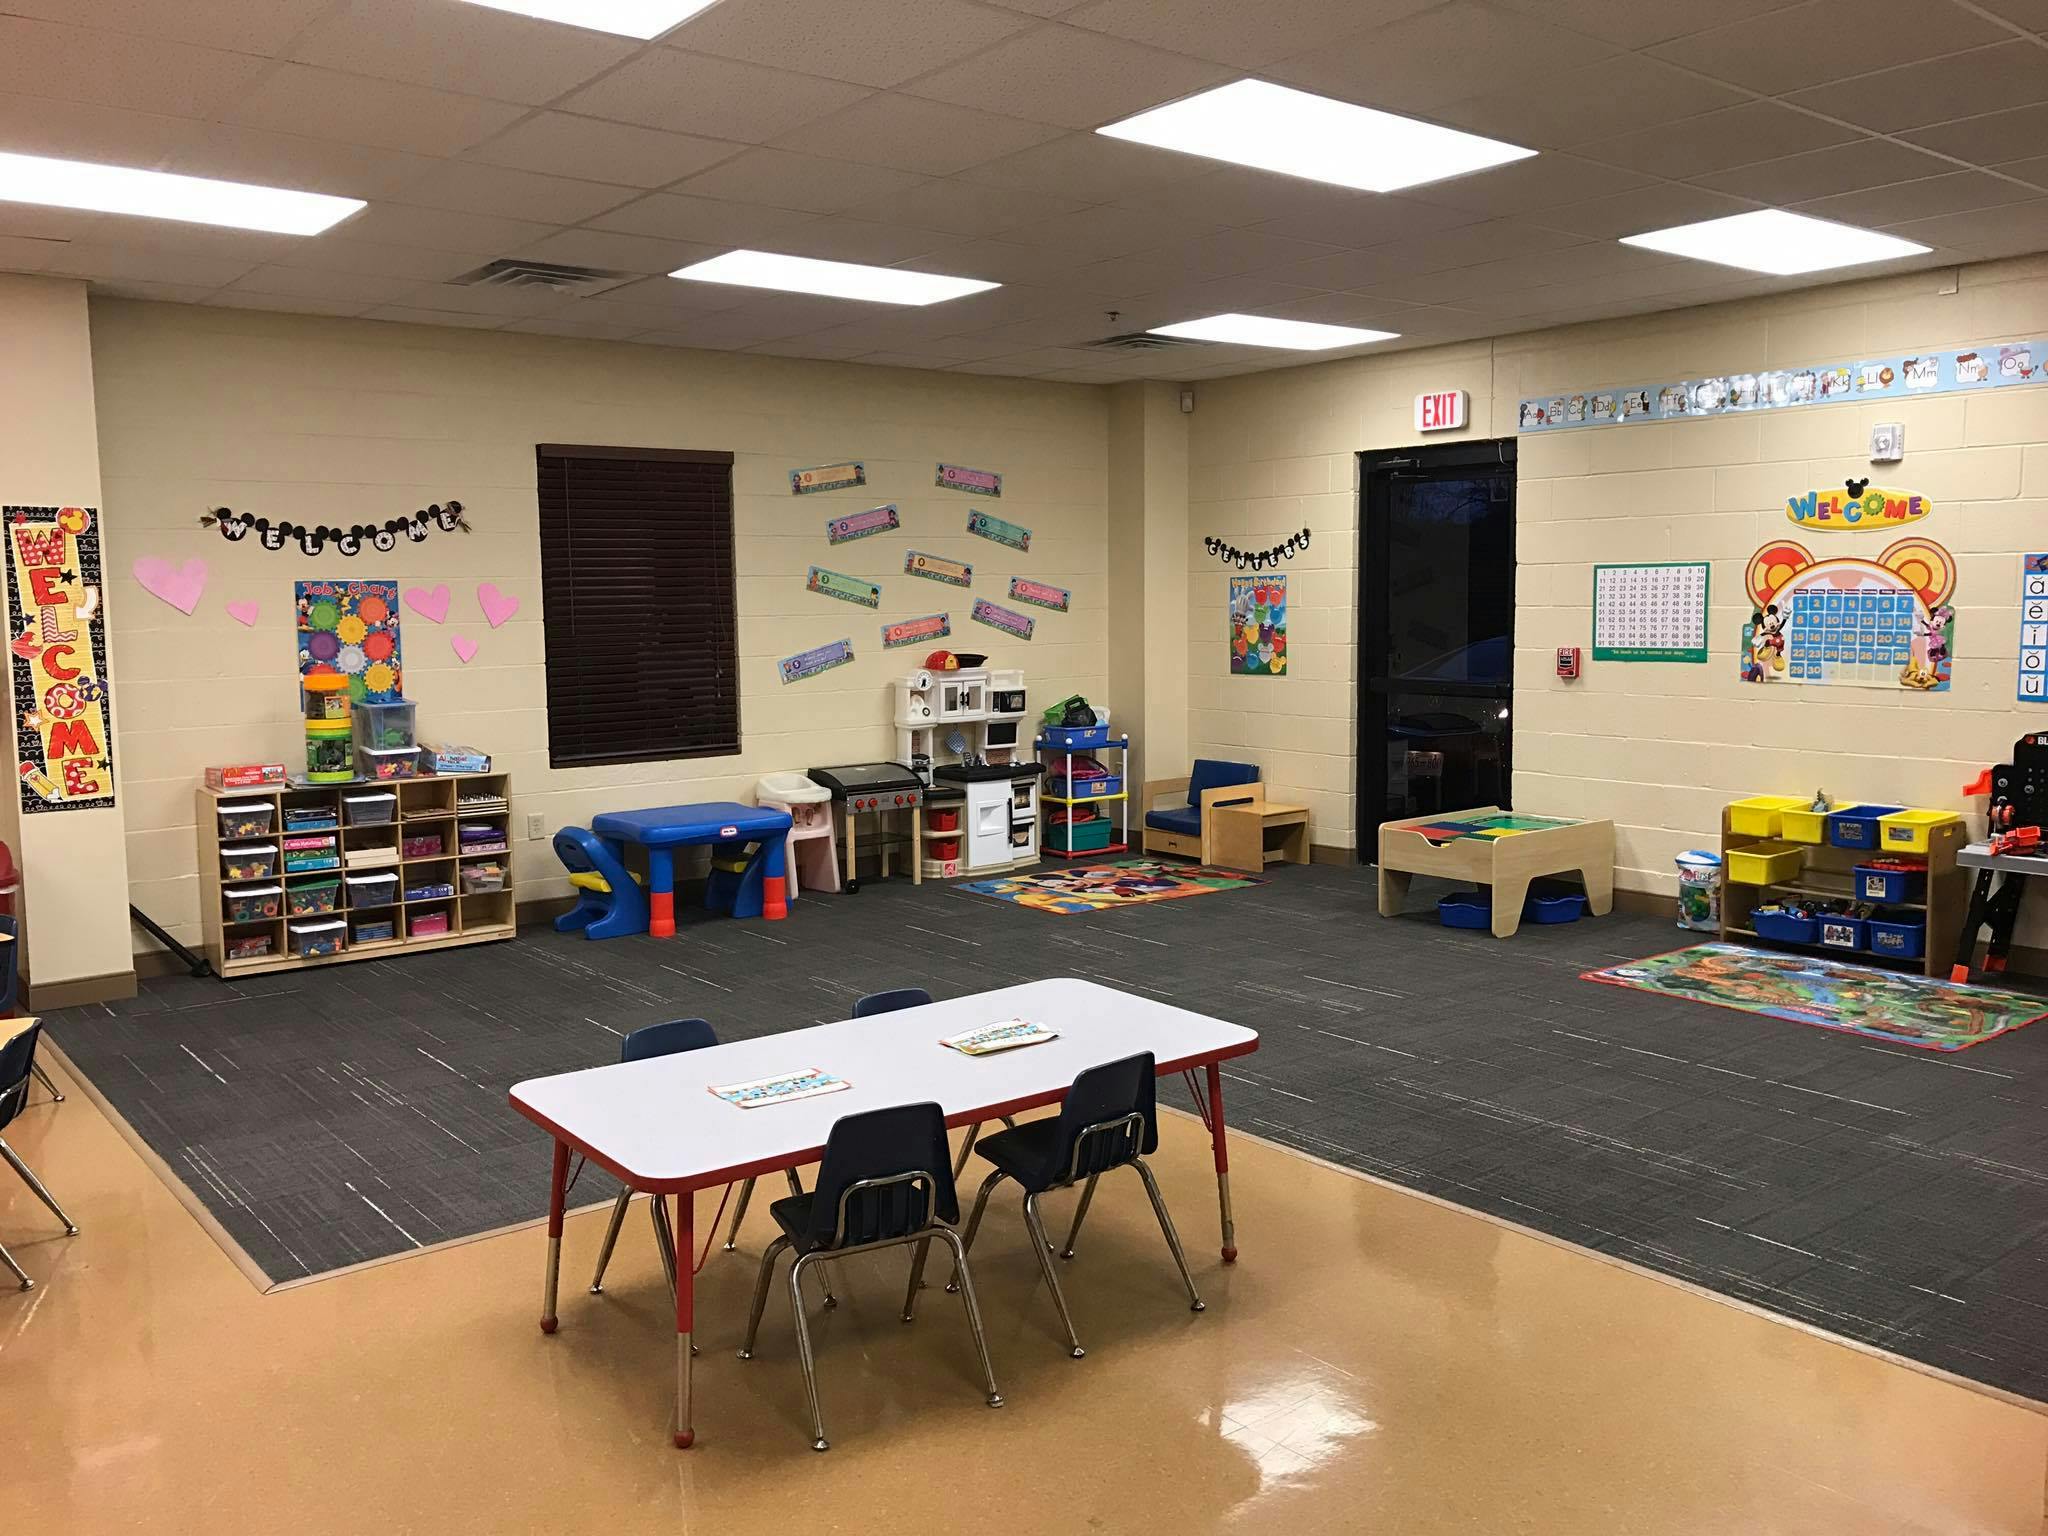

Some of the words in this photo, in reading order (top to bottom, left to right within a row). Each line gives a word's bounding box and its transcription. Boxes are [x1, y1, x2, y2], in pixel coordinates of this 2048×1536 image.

[1550, 407, 1561, 416] Bb
[1597, 401, 1609, 411] Dd
[1630, 398, 1641, 408] Ee
[1832, 375, 1848, 387] Kk
[1913, 367, 1936, 379] Mm
[1959, 363, 1976, 374] Nn
[2004, 357, 2024, 369] Oo
[1423, 392, 1457, 427] EXIT
[1788, 491, 1922, 522] WELCOME
[222, 510, 456, 555] WELCOME
[1210, 536, 1308, 570] CENTERS
[303, 582, 333, 596] Job
[348, 582, 396, 600] Chart
[1798, 600, 1803, 608] 1
[1814, 599, 1820, 608] 2
[1830, 600, 1838, 608] 3
[1866, 600, 1872, 608] 5
[1882, 600, 1890, 608] 6
[1902, 600, 1908, 608] 7
[1796, 615, 1804, 624] 8
[1812, 615, 1820, 624] 9
[1826, 616, 1840, 624] 10
[1844, 616, 1855, 624] 11
[1862, 617, 1874, 625] 12
[1898, 618, 1912, 626] 14
[1794, 633, 1804, 641] 15
[1810, 633, 1820, 641] 16
[1826, 633, 1838, 641] 17
[1842, 634, 1854, 642] 18
[1860, 635, 1873, 643] 19
[1877, 635, 1892, 643] 20
[1896, 635, 1908, 644] 21
[1559, 648, 1573, 656] FIRE
[1792, 648, 1805, 657] 22
[1807, 649, 1822, 658] 23
[1823, 649, 1838, 658] 24
[1842, 651, 1856, 659] 25
[1859, 651, 1873, 660] 26
[1876, 652, 1890, 660] 27
[15, 527, 100, 797] WELCOME
[1790, 666, 1804, 674] 29
[1808, 666, 1821, 674] 30
